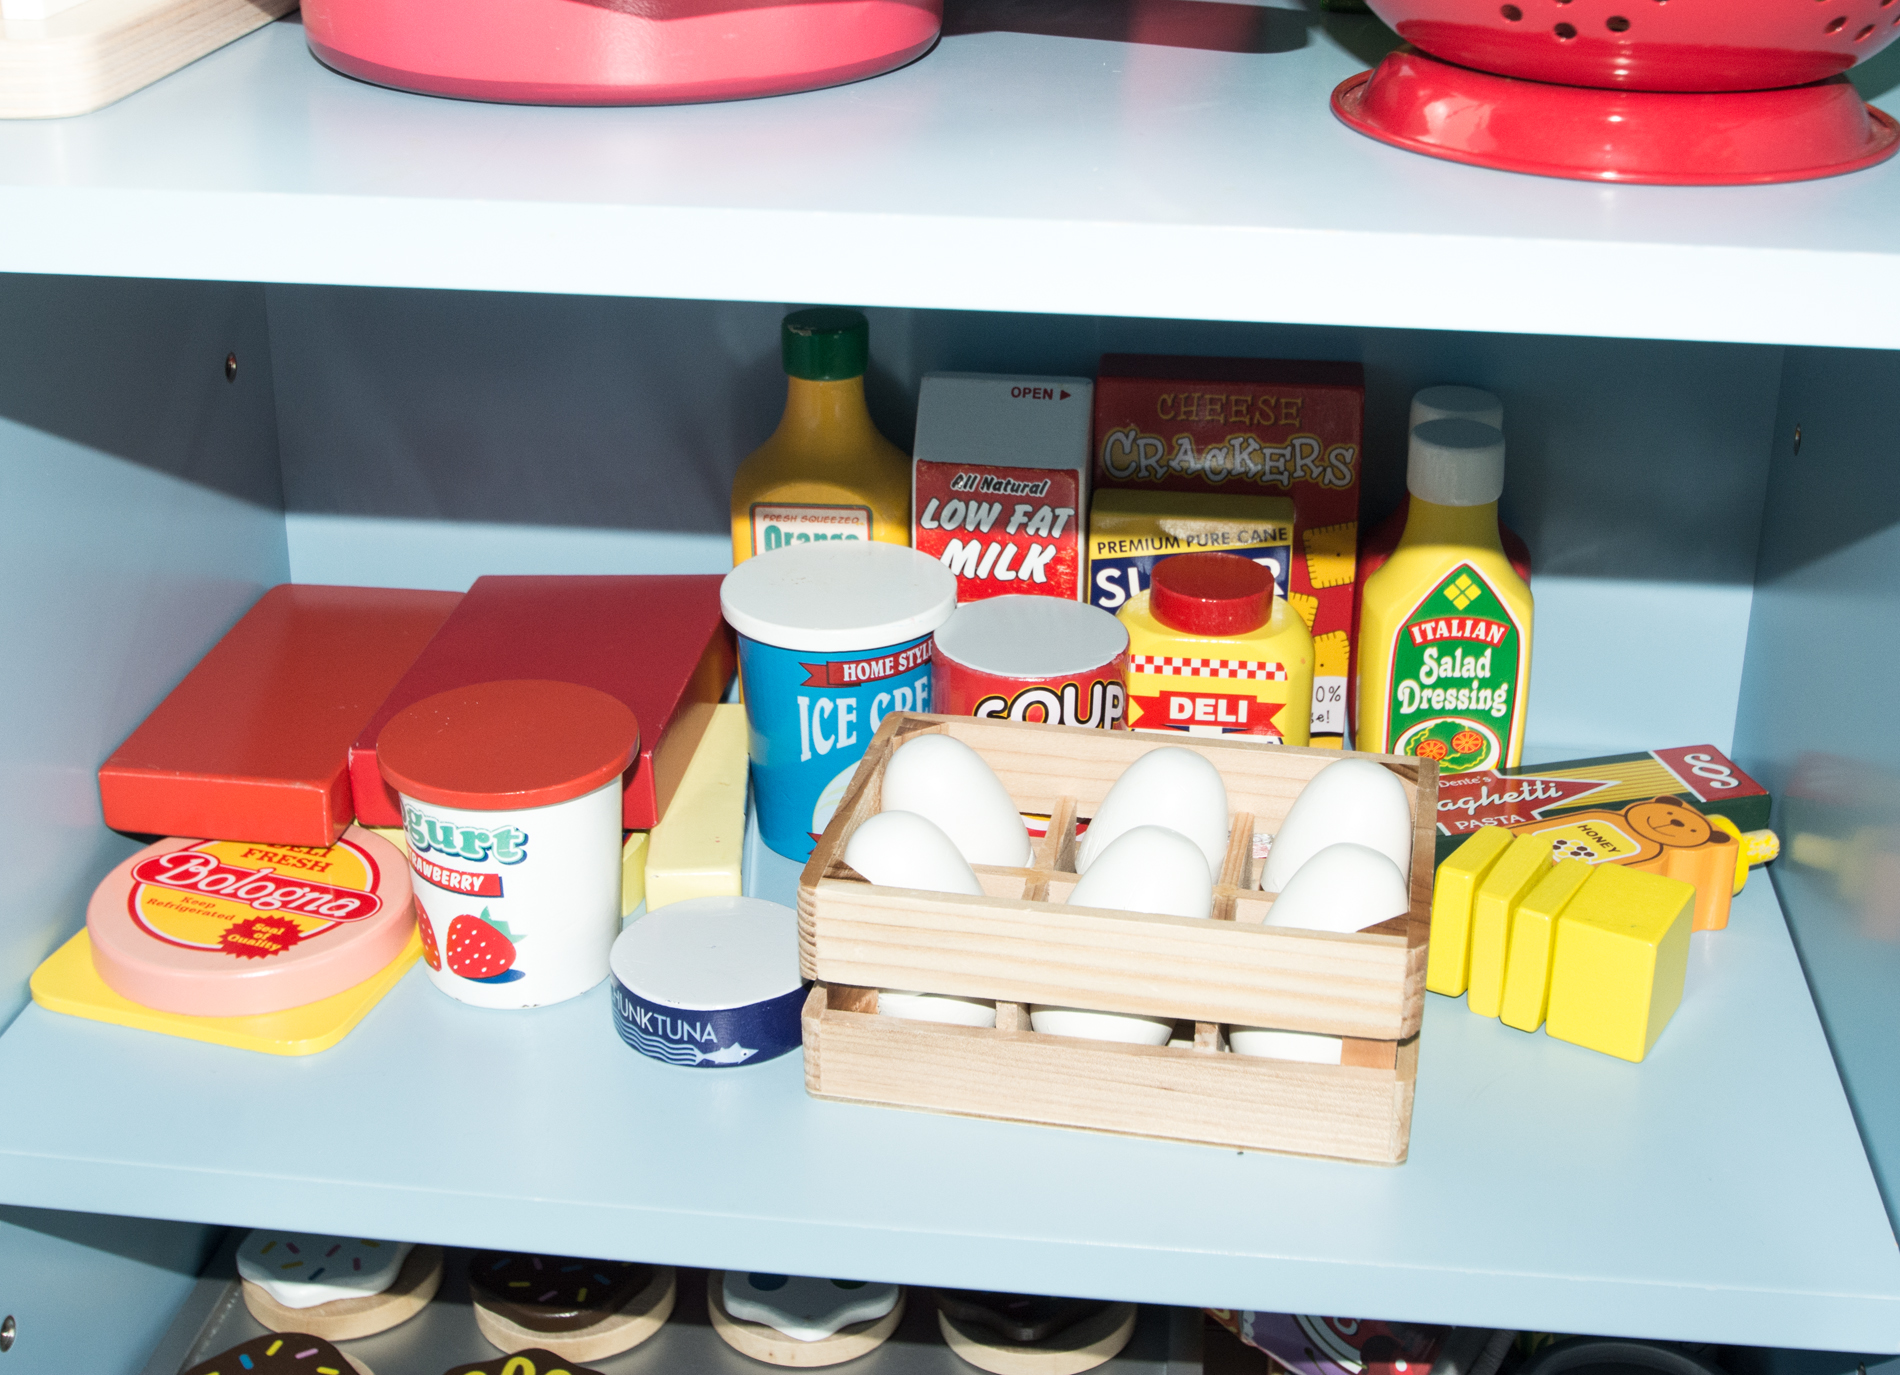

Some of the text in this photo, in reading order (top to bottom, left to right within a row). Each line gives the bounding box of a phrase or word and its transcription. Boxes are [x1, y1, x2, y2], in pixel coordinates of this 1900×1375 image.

[1010, 386, 1054, 400] OPEN
[1157, 393, 1303, 426] CHEESE
[1103, 427, 1357, 488] CRACKERS
[951, 473, 1051, 497] All Natural
[762, 514, 860, 525] FRESH SQUEEZED
[920, 497, 1076, 539] LOW FAT
[1097, 527, 1288, 555] PREMIUM PURE CANE
[940, 537, 1057, 584] MILK
[1410, 618, 1506, 644] ITALIAN
[842, 657, 894, 682] HOME
[1419, 646, 1493, 686] Salad
[1315, 685, 1341, 702] 0%
[1397, 678, 1509, 718] Dressing
[797, 675, 932, 763] ICE CRE
[1168, 695, 1249, 724] DELI
[1439, 776, 1491, 788] Dente's
[1437, 780, 1564, 816] aghetti
[402, 805, 527, 863] gurt
[1454, 814, 1526, 830] PASTA
[1577, 824, 1622, 854] HONEY
[239, 847, 334, 873] FRESH
[154, 850, 361, 918] Bologna
[146, 897, 236, 921] Refrigerated
[180, 896, 216, 910] Keep
[252, 922, 286, 935] Seal
[252, 931, 272, 941] of
[226, 933, 282, 951] Quality
